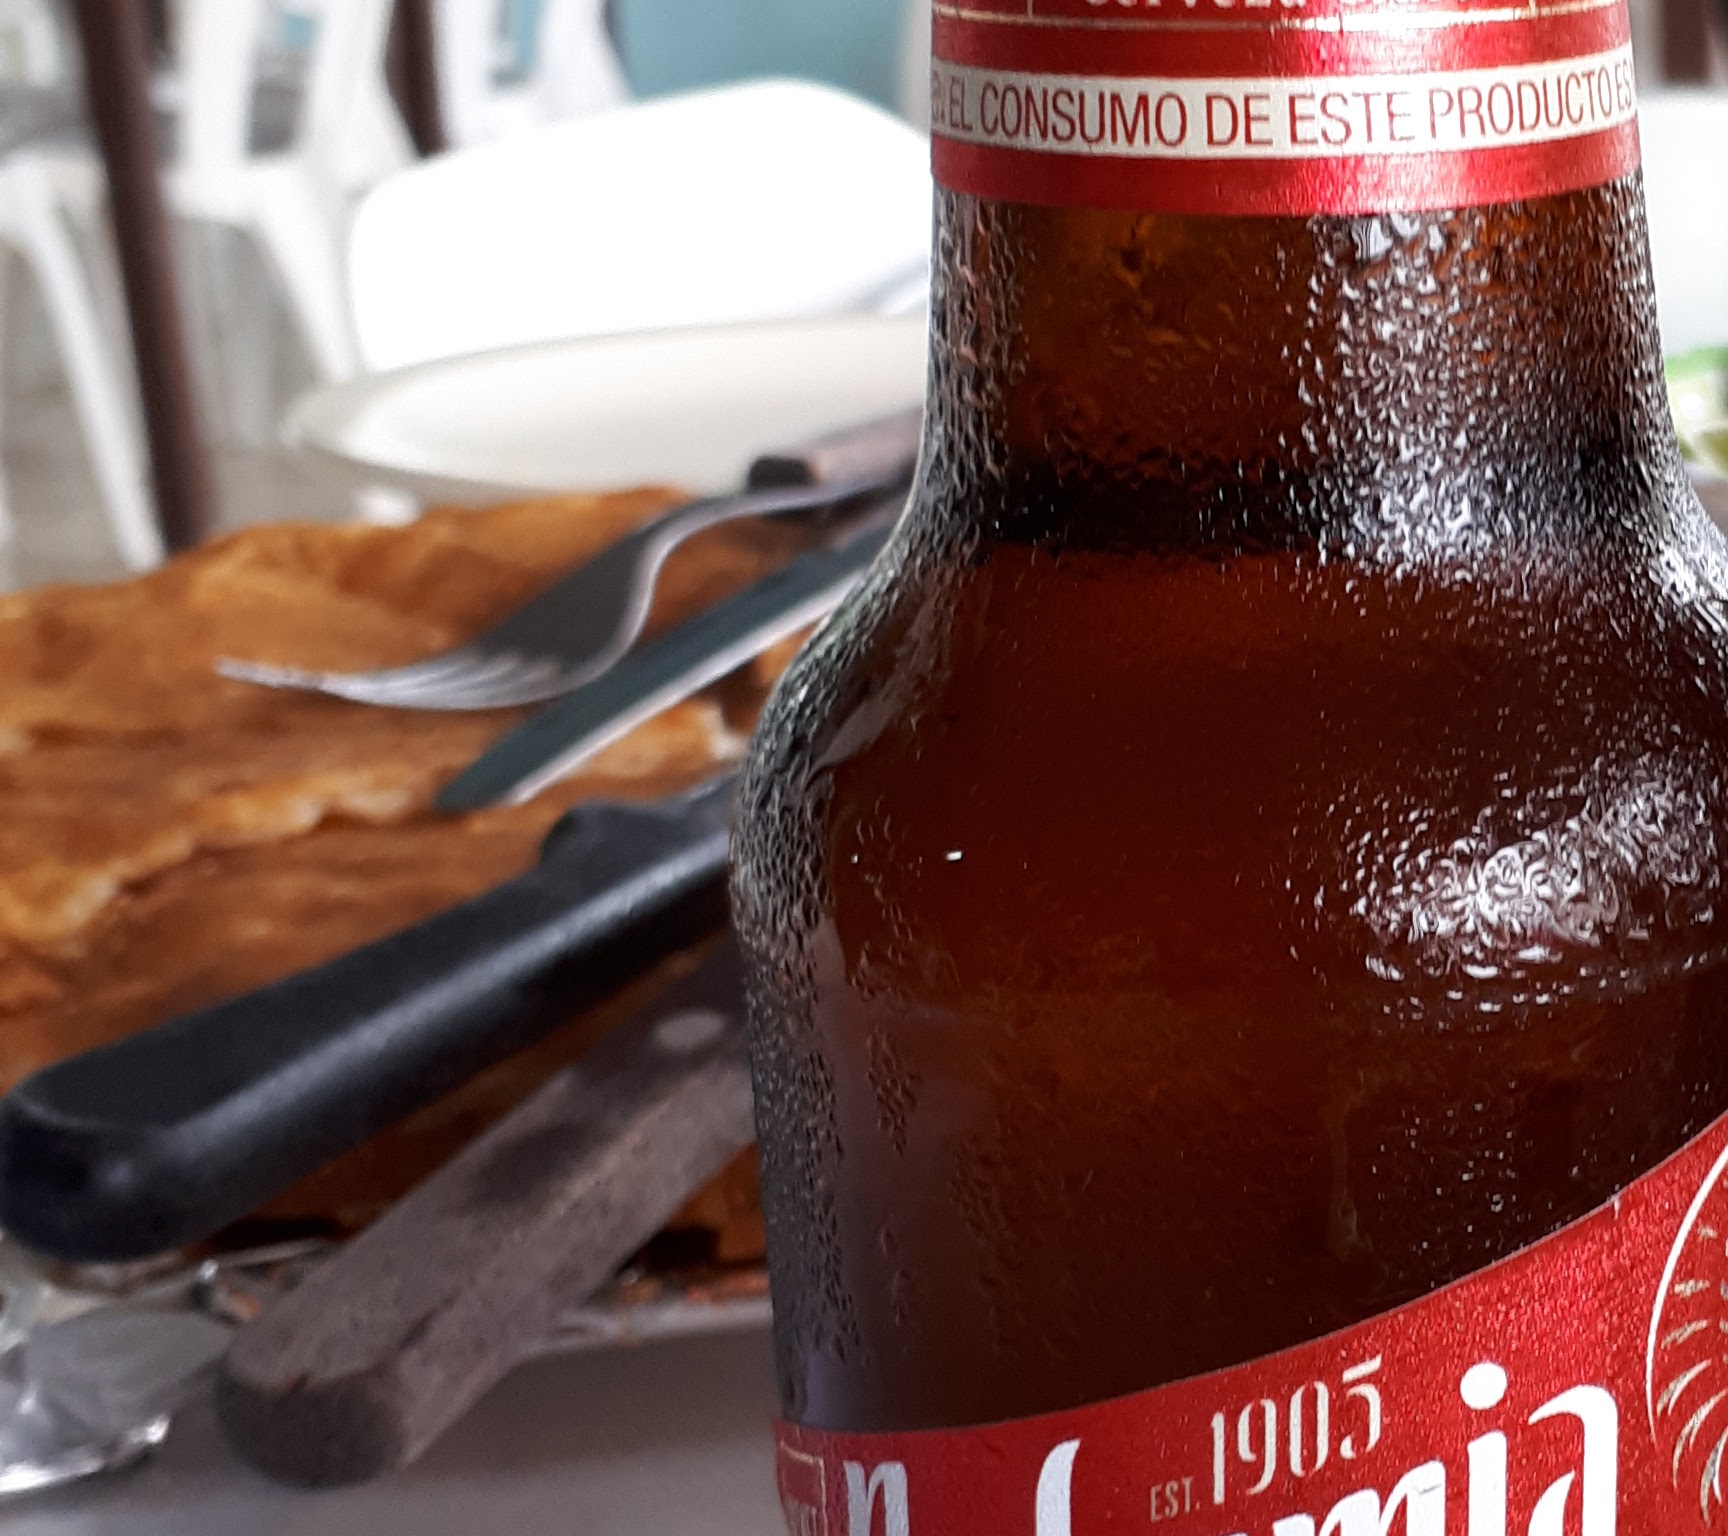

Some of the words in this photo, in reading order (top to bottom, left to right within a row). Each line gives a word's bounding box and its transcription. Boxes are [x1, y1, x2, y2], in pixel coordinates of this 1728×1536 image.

[949, 75, 974, 133] EL
[979, 81, 1189, 149] CONSUMO
[1204, 91, 1275, 150] DE
[1288, 88, 1417, 150] ESTE
[1427, 65, 1613, 141] PRODUCTO
[1149, 1476, 1201, 1525] EST.
[1210, 1353, 1384, 1506] 1905
